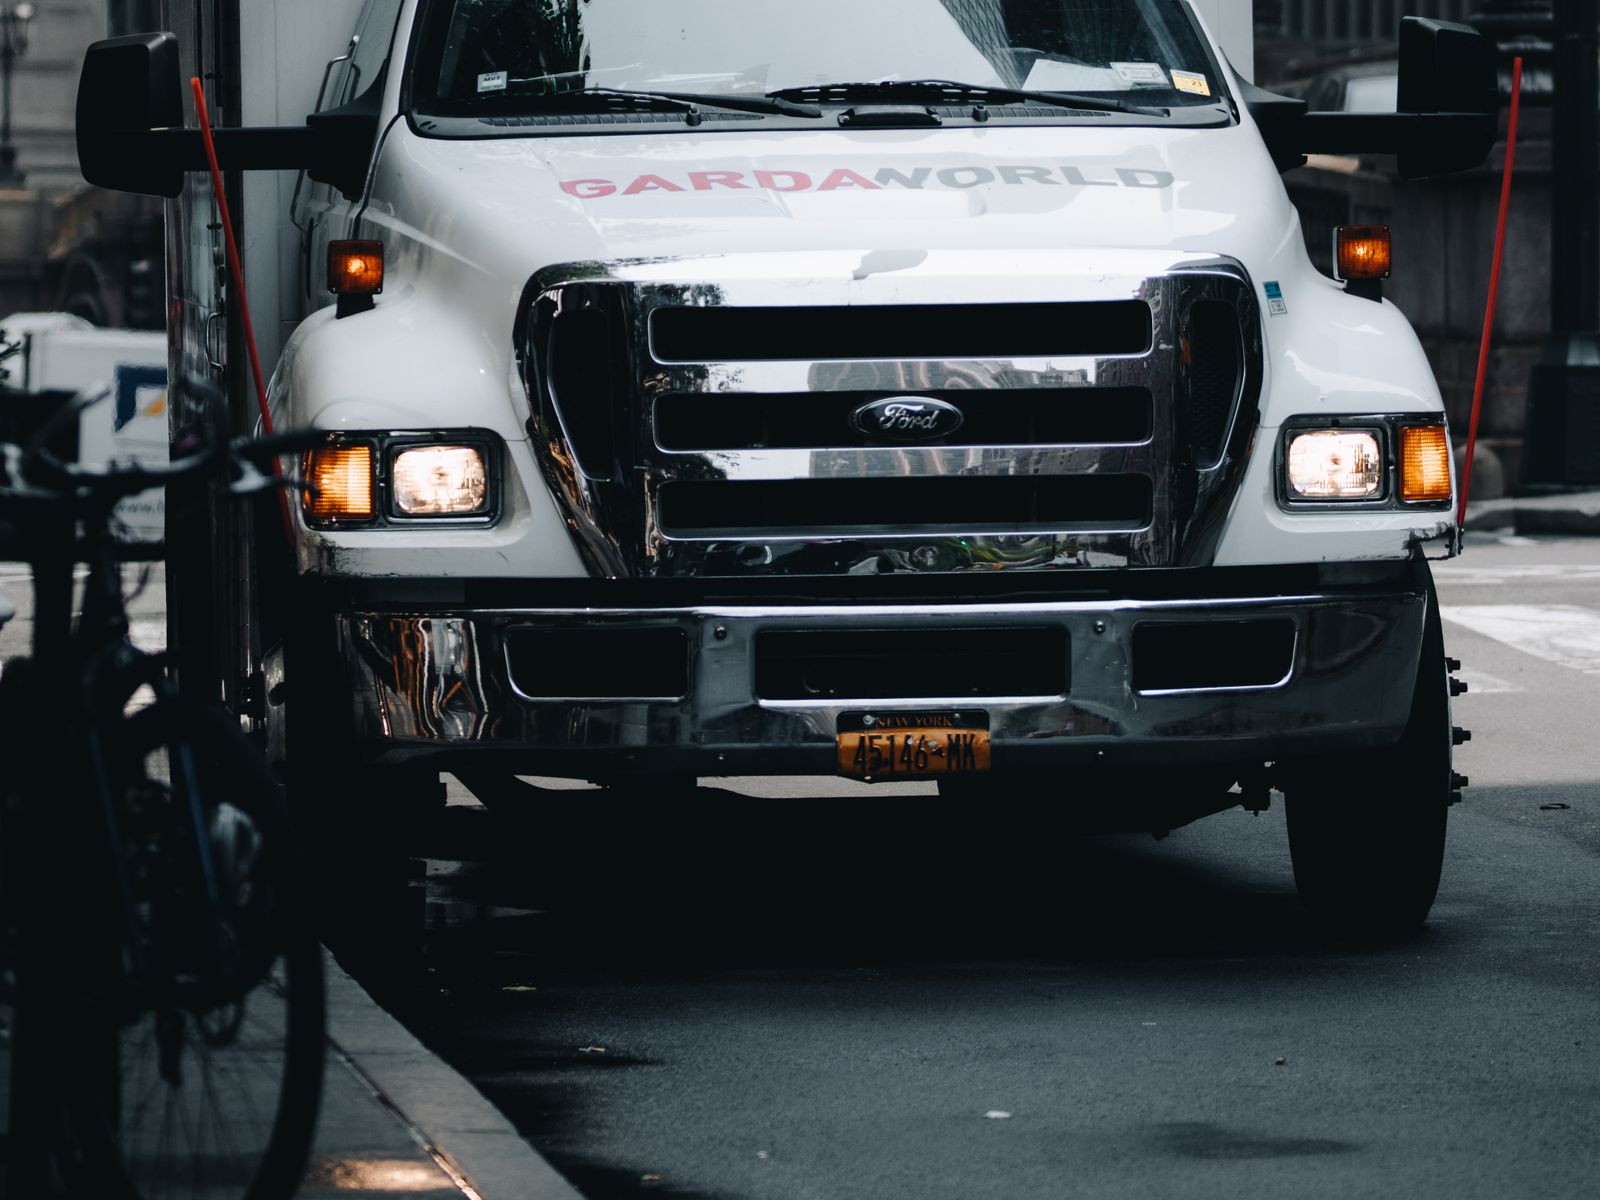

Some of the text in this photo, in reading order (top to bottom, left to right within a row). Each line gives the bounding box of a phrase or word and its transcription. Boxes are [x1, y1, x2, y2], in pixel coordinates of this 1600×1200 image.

[559, 166, 1175, 199] GARDAWORLD
[878, 403, 941, 430] Ford
[875, 715, 953, 729] NEW YORK
